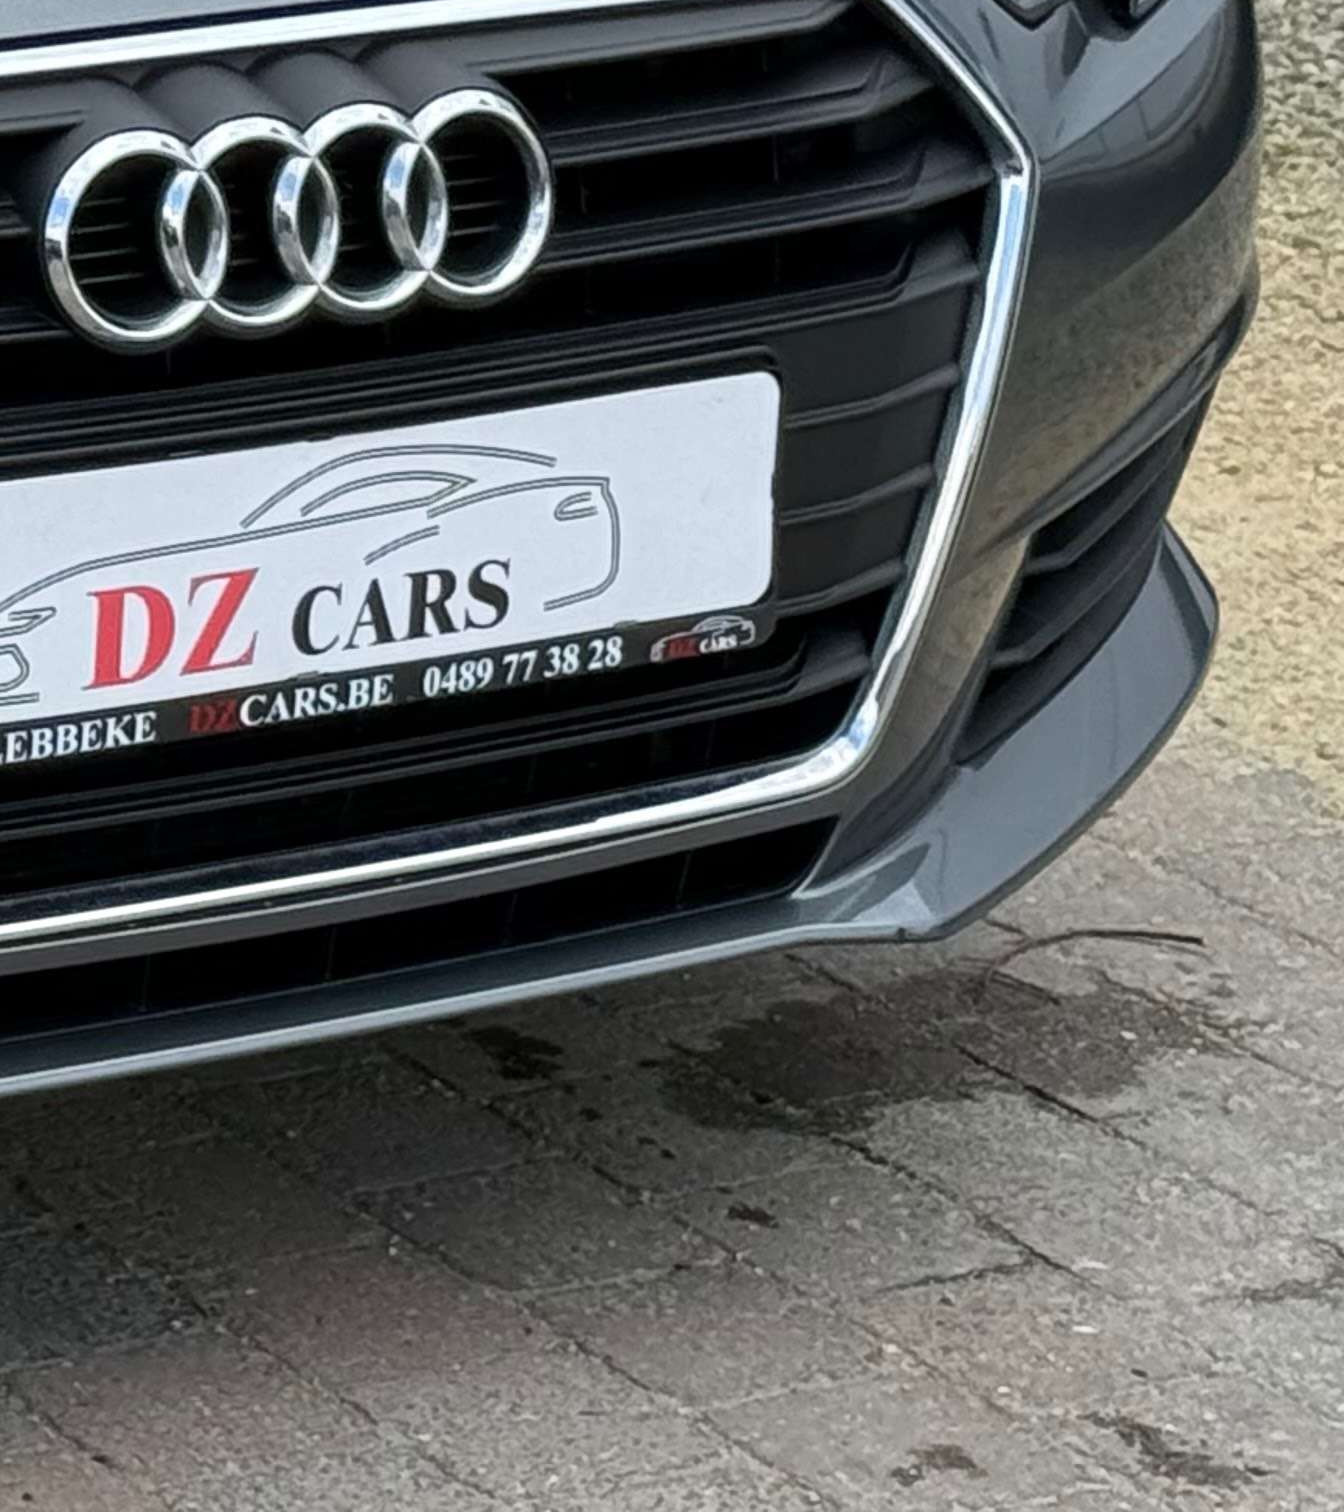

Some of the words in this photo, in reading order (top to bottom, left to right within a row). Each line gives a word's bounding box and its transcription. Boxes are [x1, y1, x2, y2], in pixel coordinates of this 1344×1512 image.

[82, 567, 260, 690] DZ
[291, 557, 512, 656] CARS
[423, 656, 493, 698] 0489
[502, 649, 539, 683] 77
[543, 643, 580, 678] 38
[587, 635, 624, 671] 28
